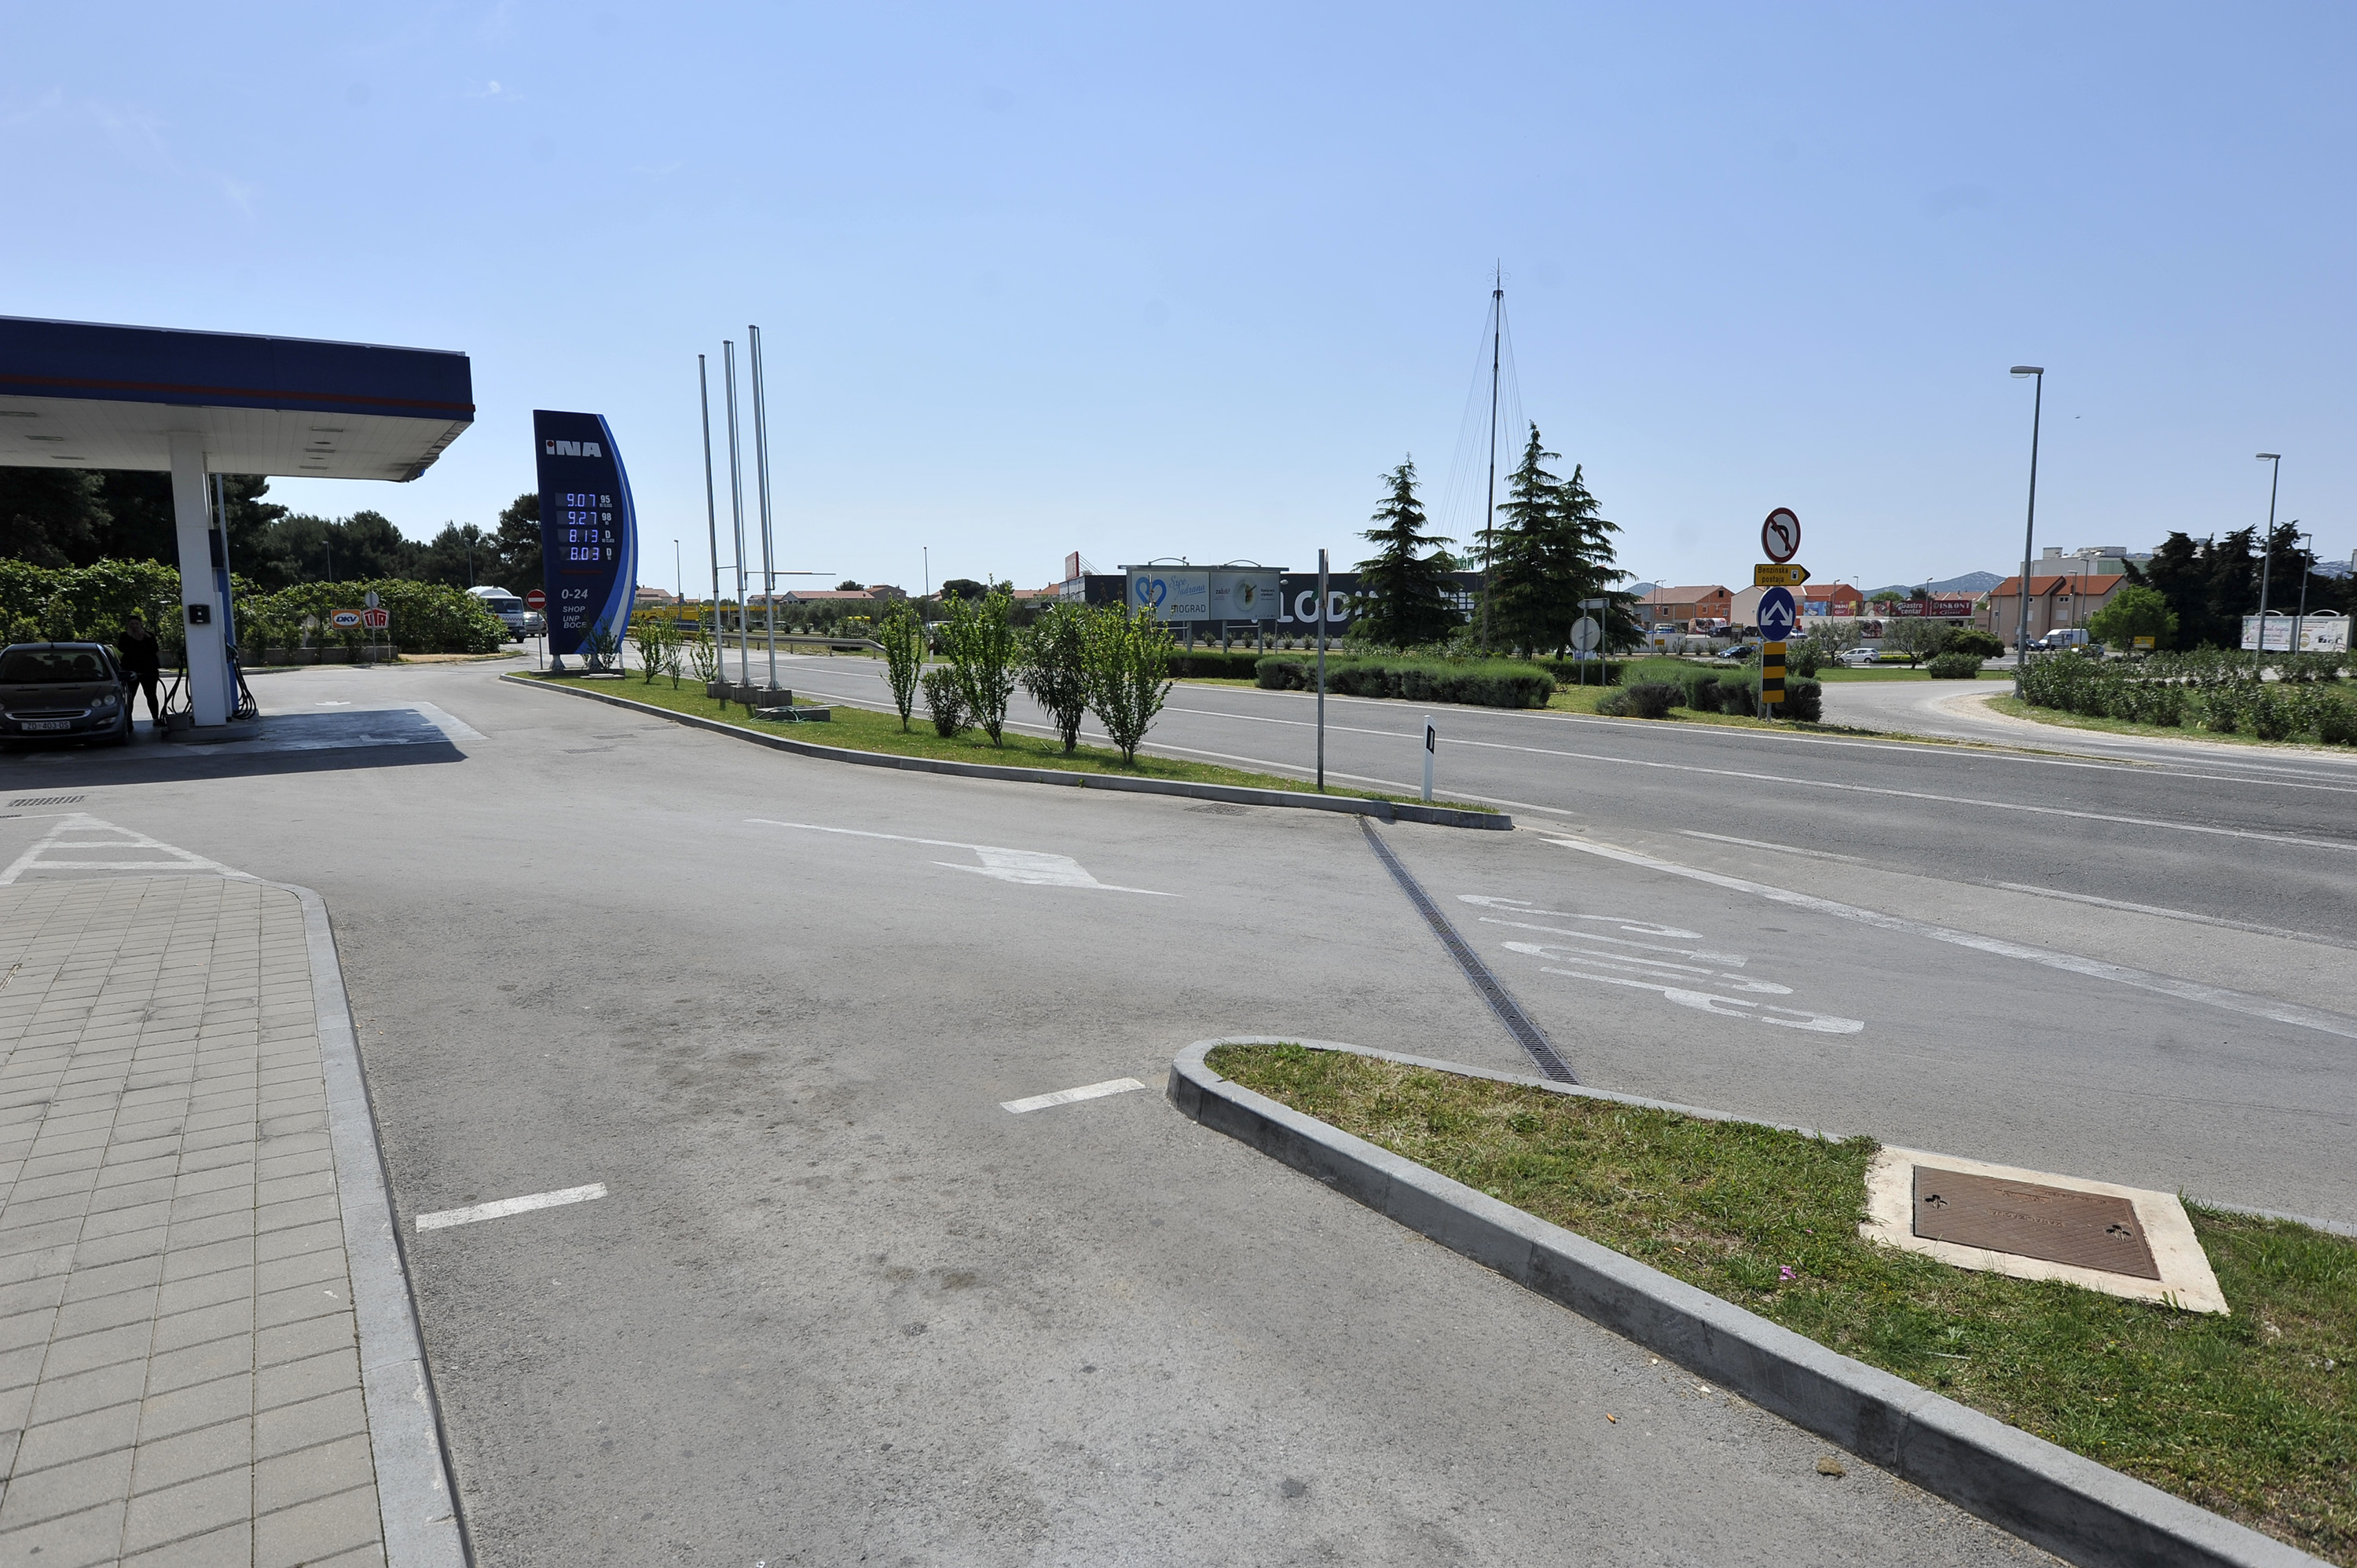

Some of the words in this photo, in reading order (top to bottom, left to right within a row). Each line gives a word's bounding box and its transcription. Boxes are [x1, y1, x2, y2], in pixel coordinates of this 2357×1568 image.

[545, 440, 602, 458] INA
[566, 493, 596, 507] 9.07
[600, 495, 610, 504] 95
[568, 511, 597, 525] 9.27
[602, 512, 612, 521] 98
[569, 529, 599, 543] 8.13
[605, 530, 610, 539] D
[570, 547, 599, 561] 8.03
[606, 548, 612, 556] D
[561, 588, 588, 599] 0-24
[1455, 894, 1866, 1035] STOP
